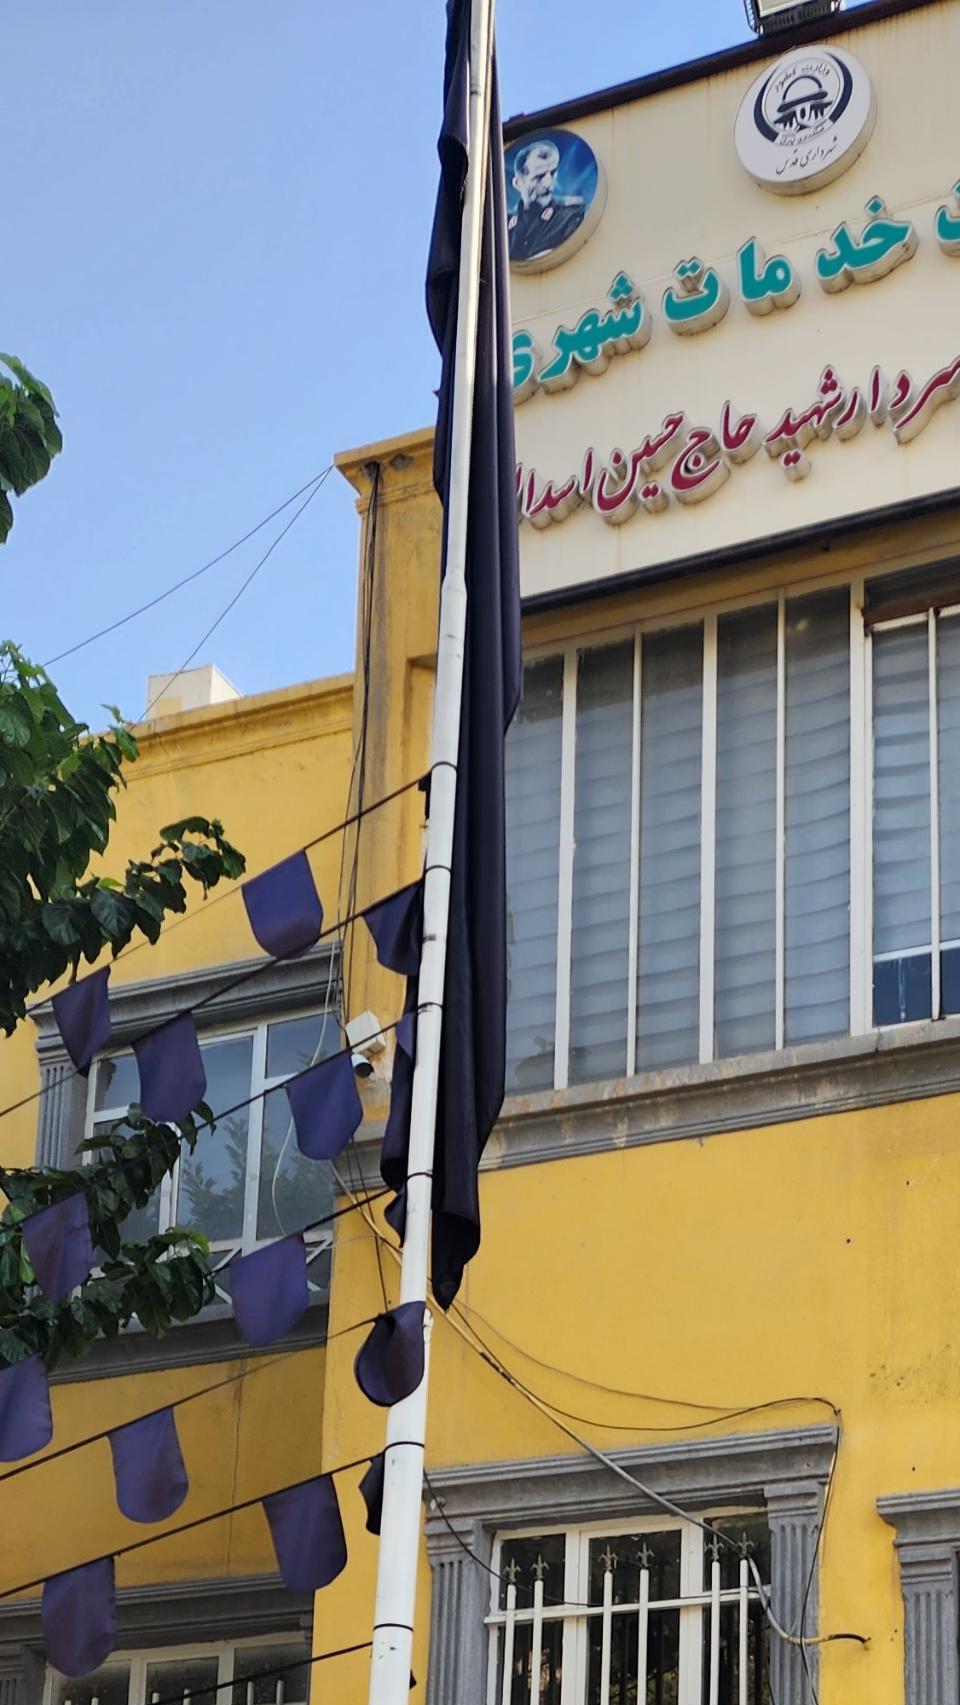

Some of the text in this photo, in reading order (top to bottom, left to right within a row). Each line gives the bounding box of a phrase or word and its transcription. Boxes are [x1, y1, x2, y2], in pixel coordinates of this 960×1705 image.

[776, 147, 800, 175] قدس
[799, 135, 838, 168] شهرداری
[594, 410, 686, 514] حسین
[671, 400, 758, 493] حاج
[763, 364, 843, 468] شهید
